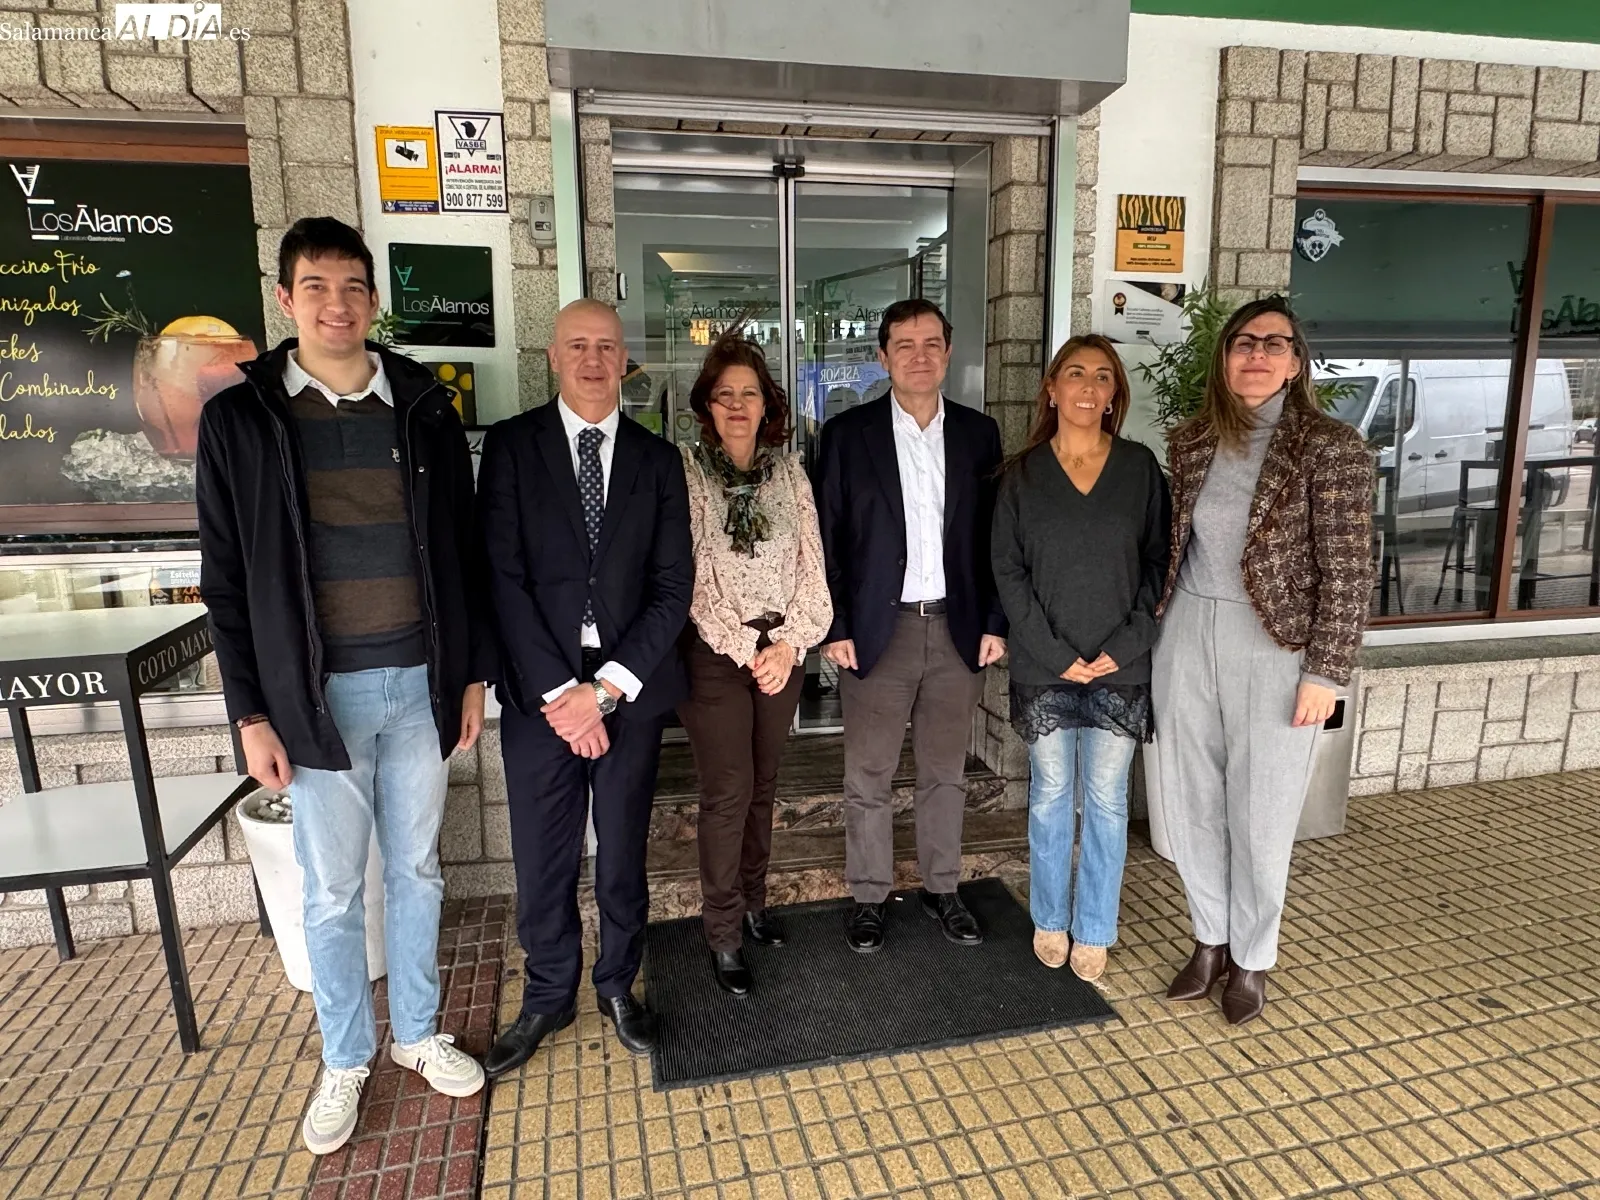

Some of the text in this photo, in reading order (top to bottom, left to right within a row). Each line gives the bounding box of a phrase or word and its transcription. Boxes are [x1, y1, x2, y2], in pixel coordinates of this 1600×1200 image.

[457, 141, 485, 149] VASBE
[445, 164, 502, 175] ¡ALARMA!
[446, 192, 464, 207] 900
[466, 193, 483, 207] 877
[486, 193, 504, 208] 599
[54, 250, 101, 283] Frío
[0, 370, 119, 402] Combinados
[138, 645, 178, 685] COTO
[0, 671, 108, 701] AYOR
